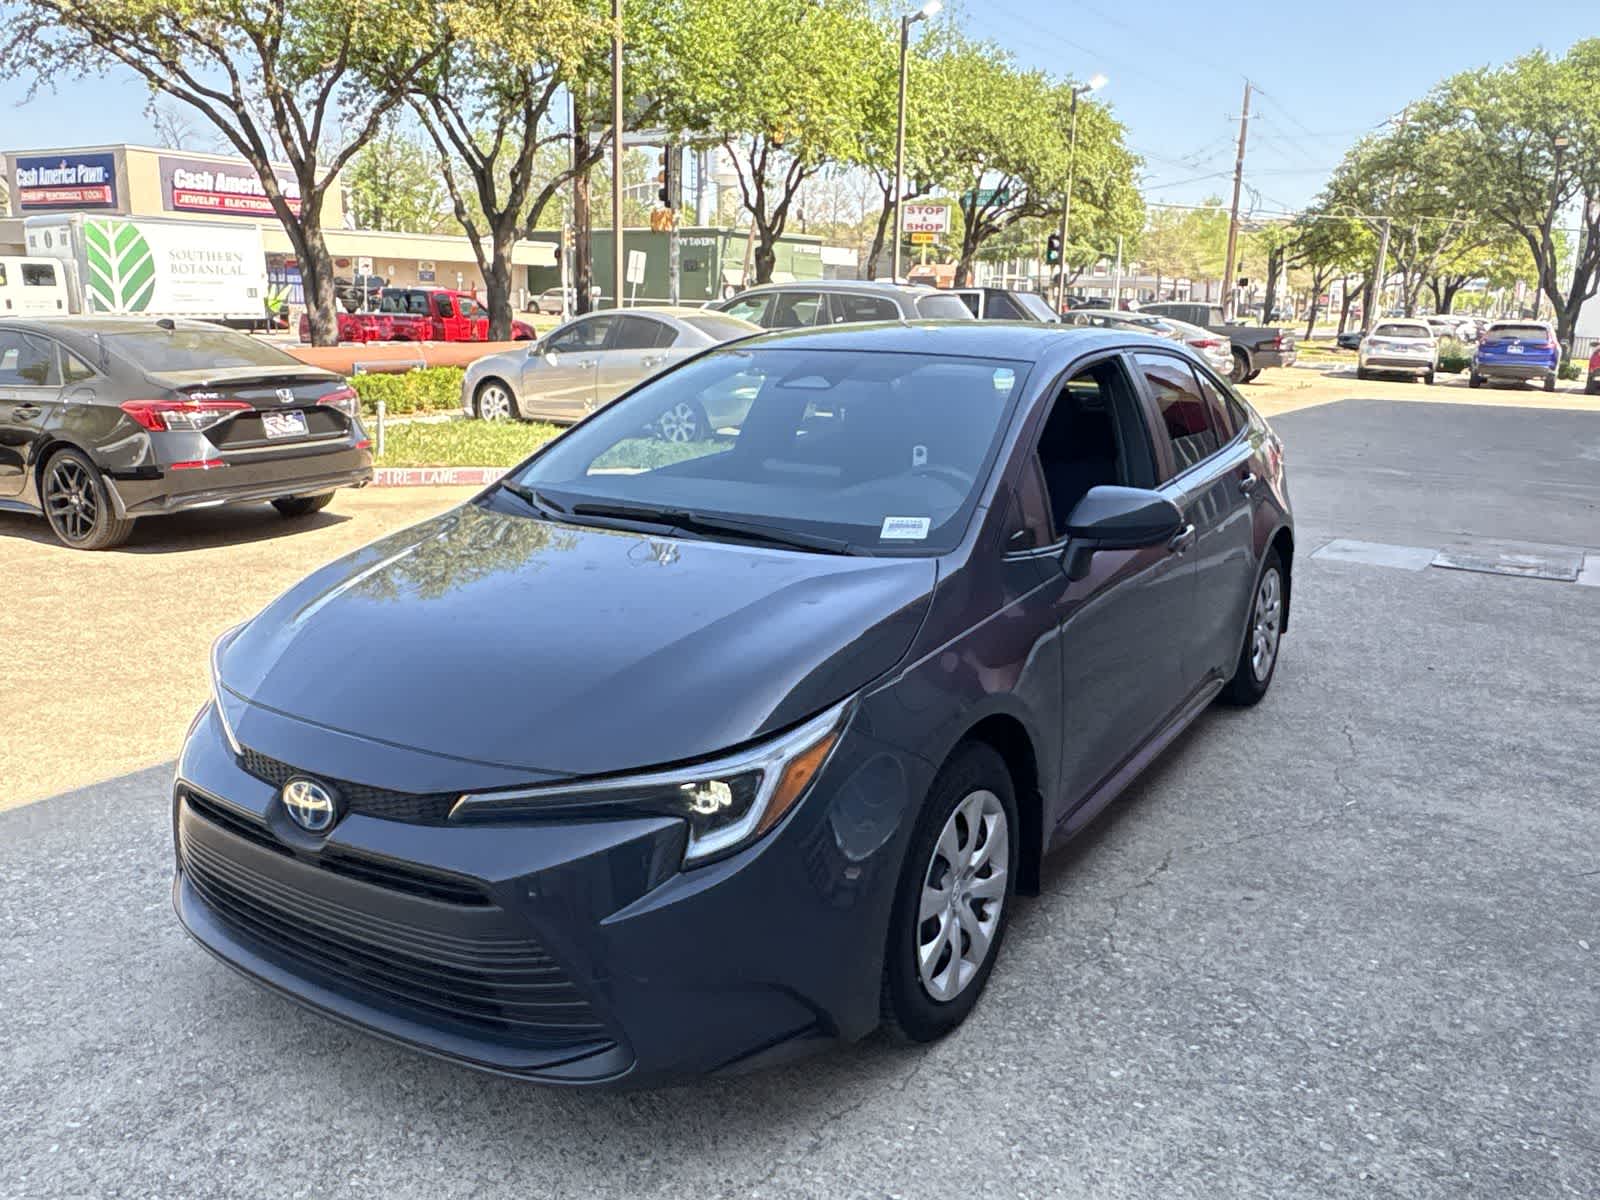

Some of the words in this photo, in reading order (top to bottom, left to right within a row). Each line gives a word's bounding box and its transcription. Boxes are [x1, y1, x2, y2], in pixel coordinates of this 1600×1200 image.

[16, 167, 38, 187] Cash
[39, 166, 76, 186] America
[77, 163, 105, 183] Pawn
[174, 168, 214, 191] Cash
[179, 195, 220, 206] JEWELRY
[907, 207, 945, 215] STOP
[906, 223, 944, 231] SHOP
[168, 248, 243, 263] SOUTHERN
[170, 263, 249, 276] BOTANICAL
[374, 470, 411, 485] FIRE
[421, 470, 458, 485] LANE
